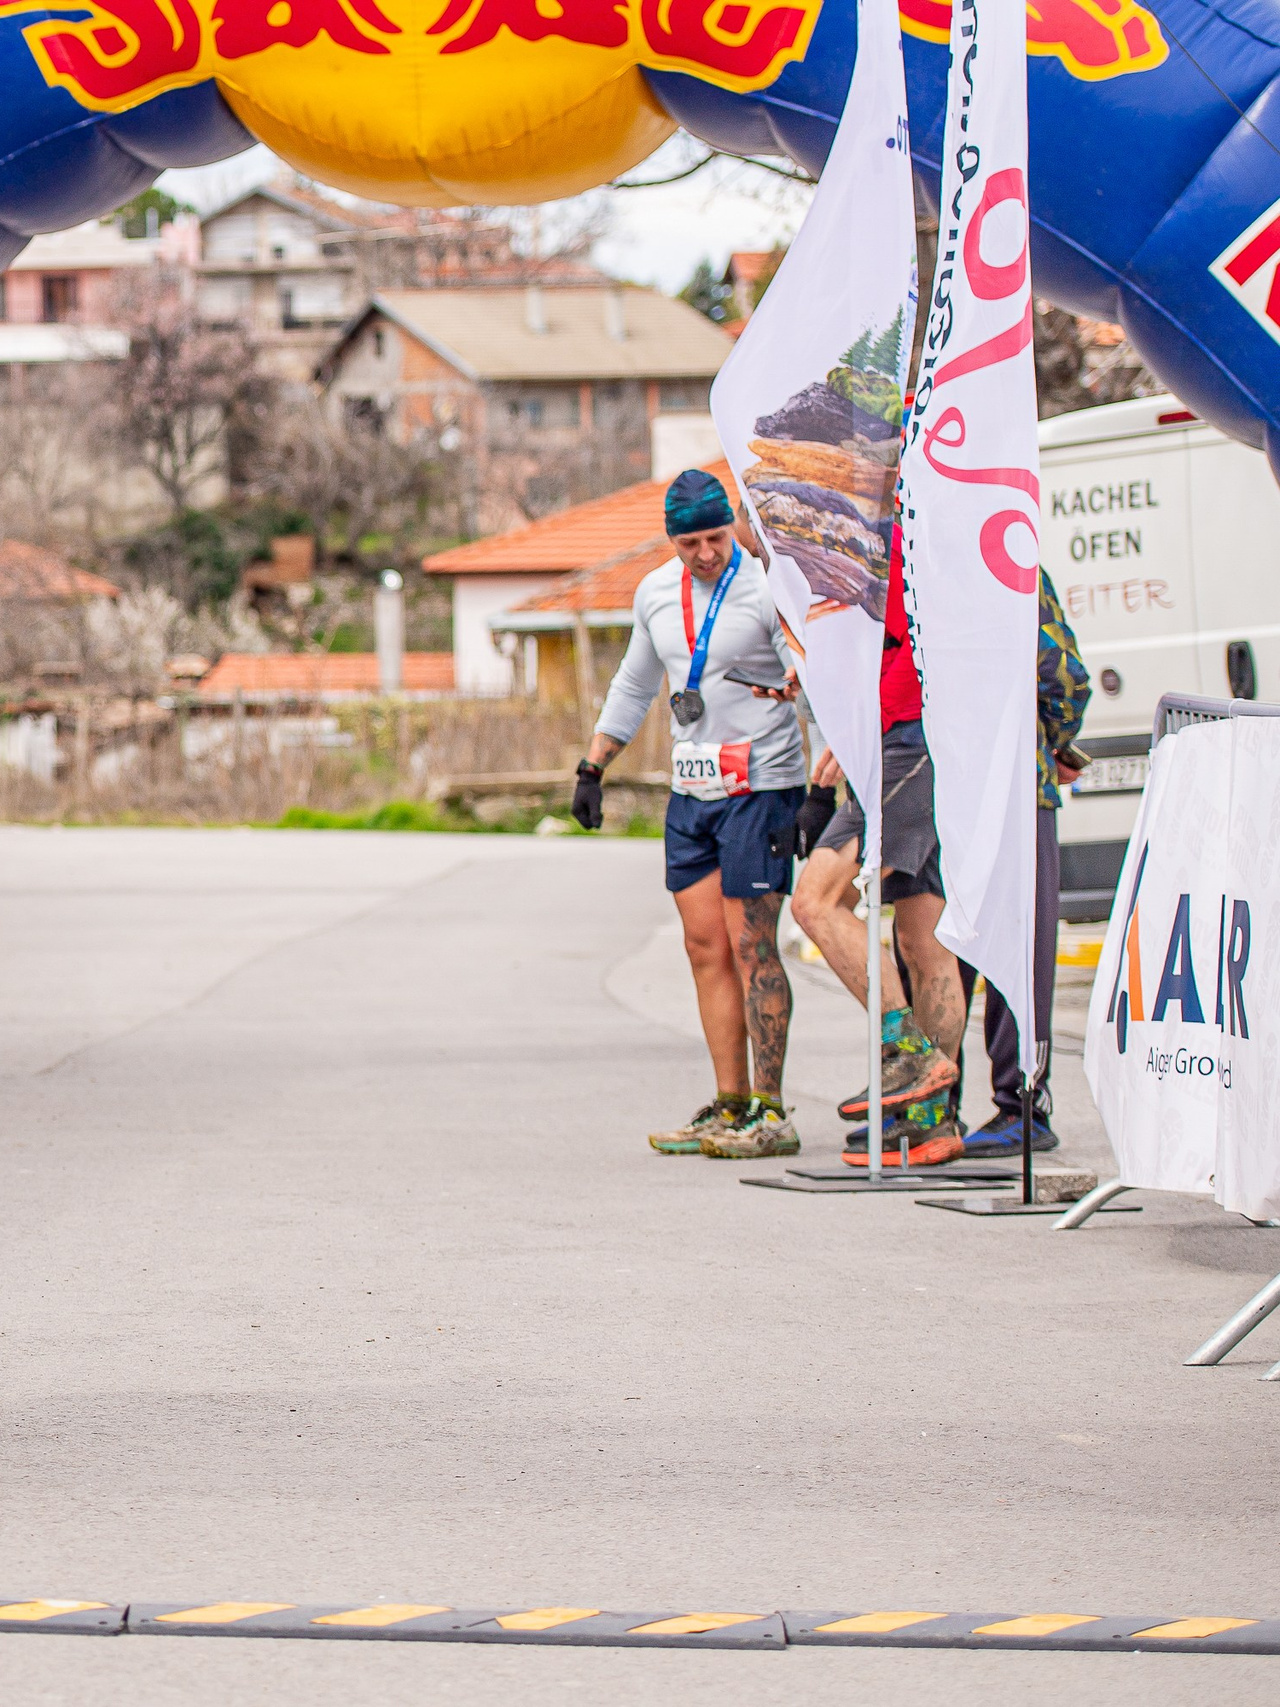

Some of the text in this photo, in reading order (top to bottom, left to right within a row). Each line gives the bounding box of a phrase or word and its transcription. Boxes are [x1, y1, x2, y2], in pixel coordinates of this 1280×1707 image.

[1051, 481, 1159, 517] KACHEL
[1070, 527, 1142, 562] ÖFEN
[676, 759, 716, 778] 2273
